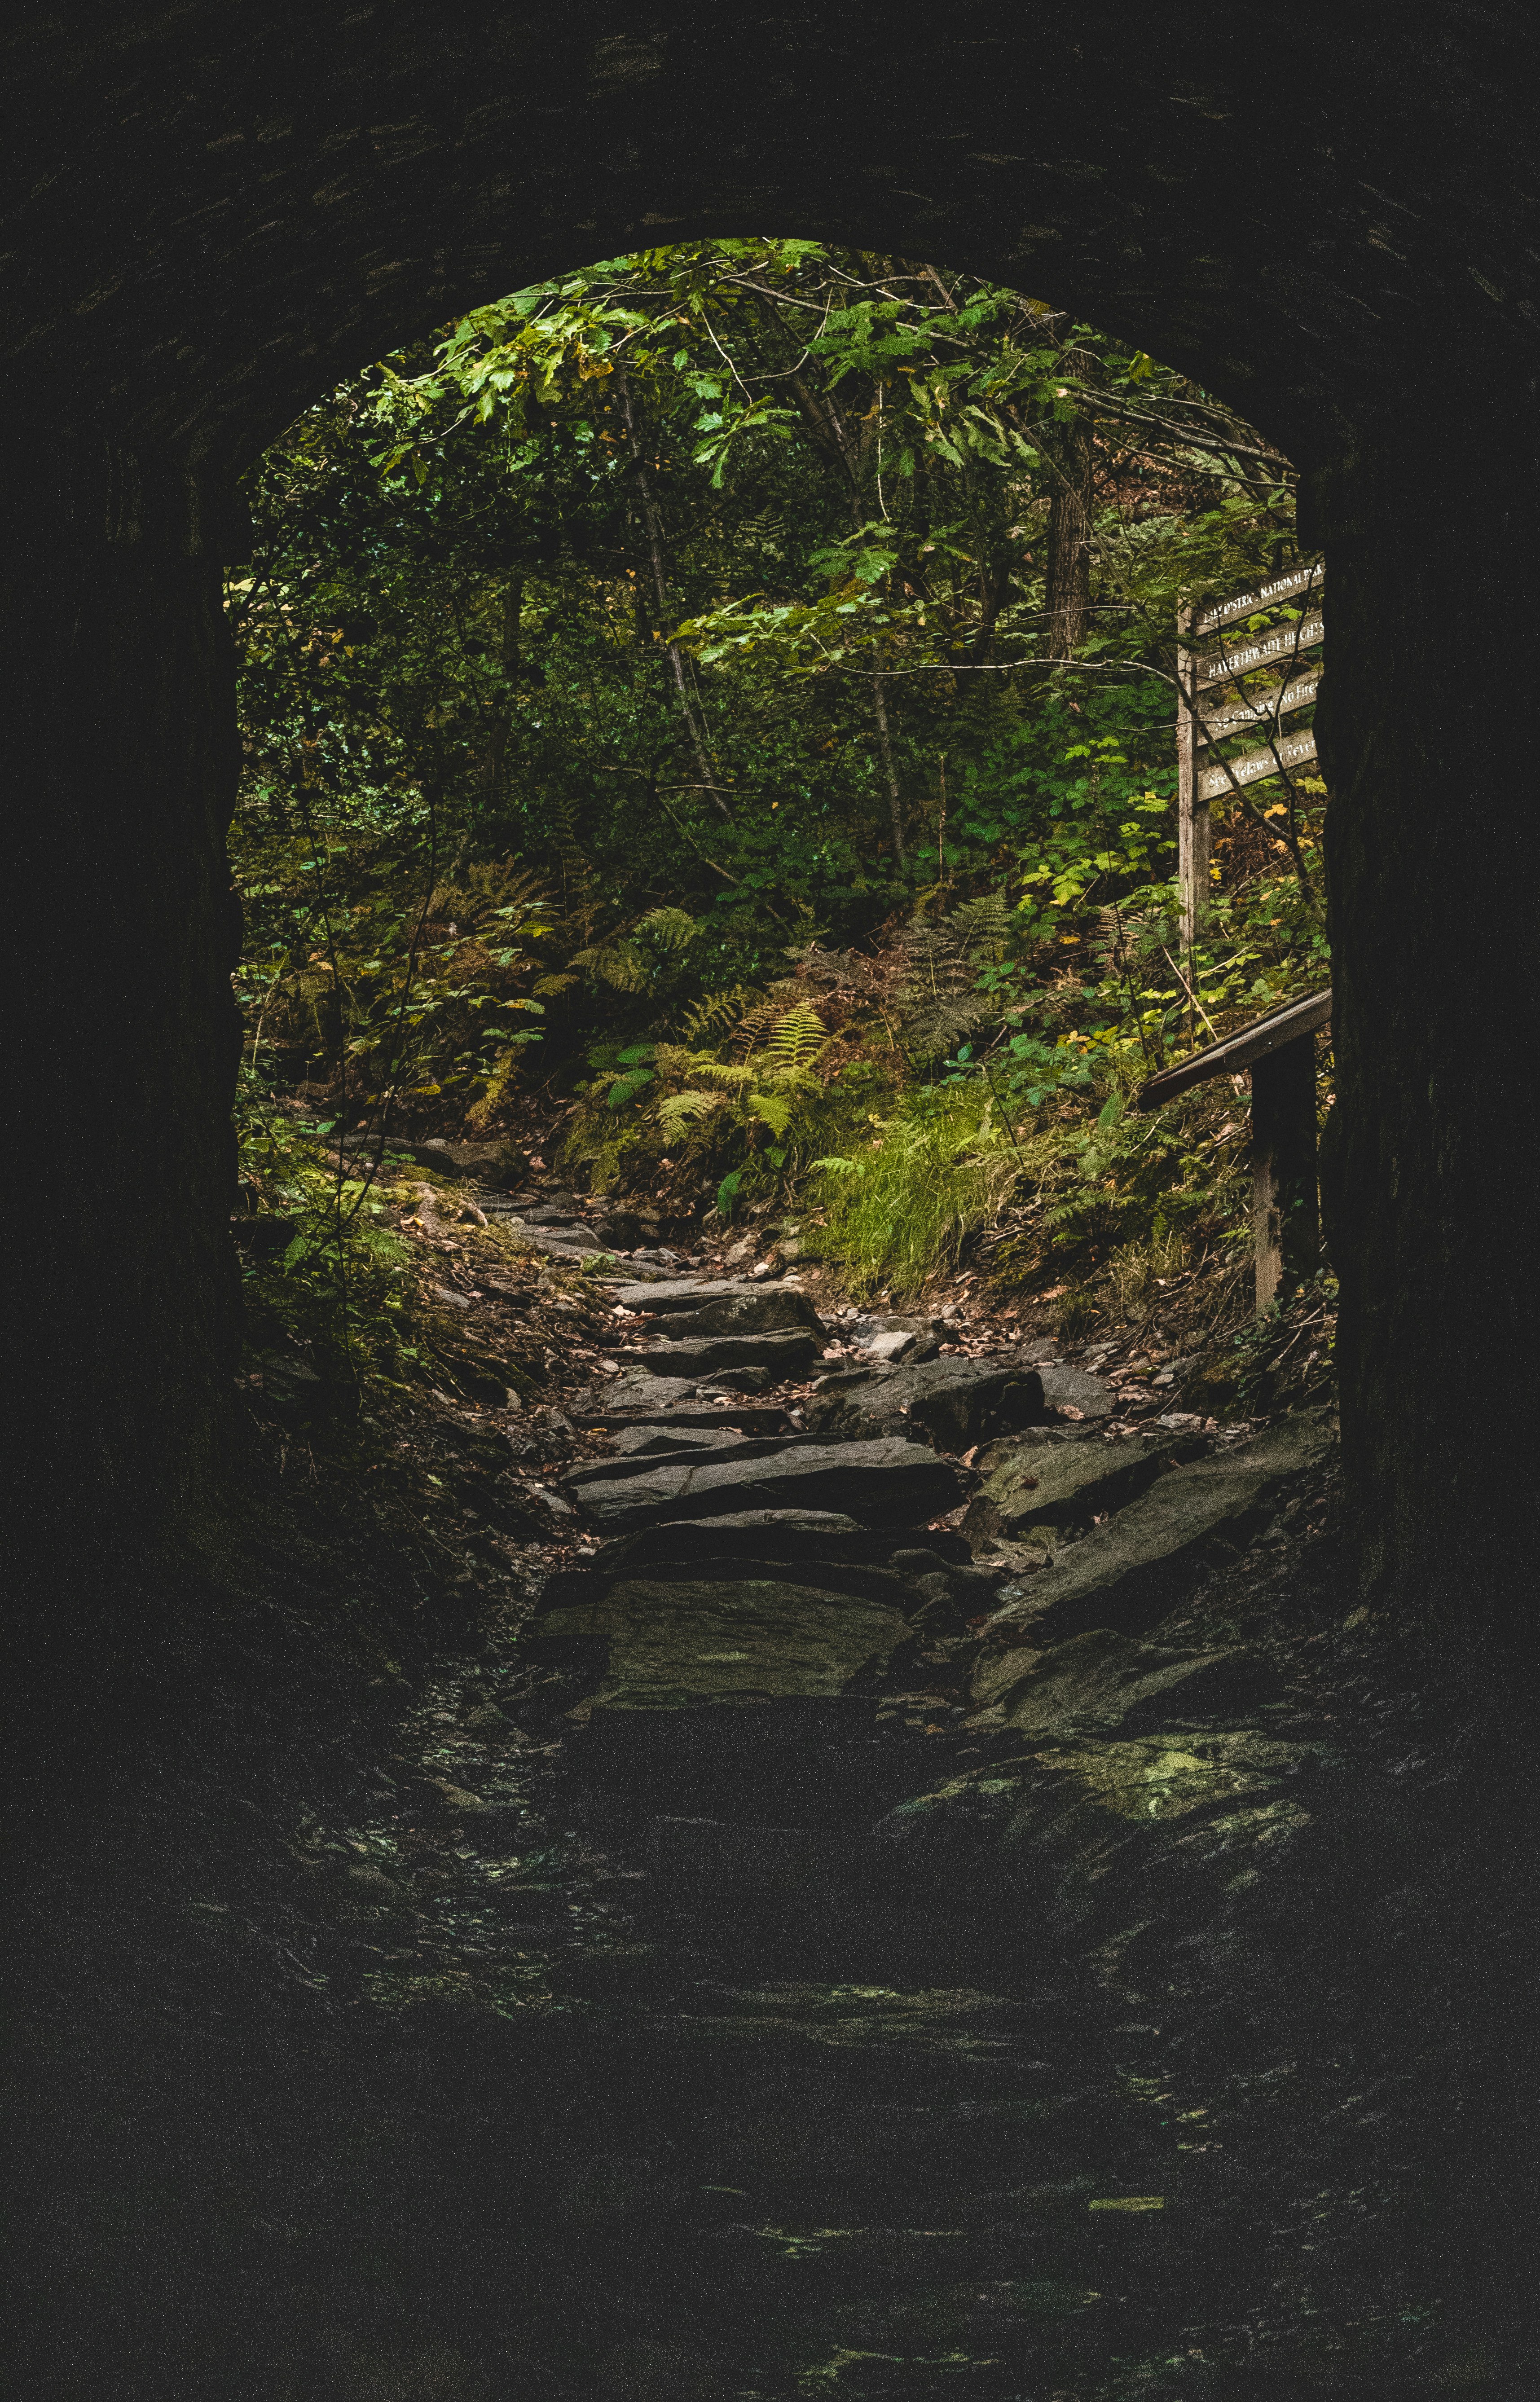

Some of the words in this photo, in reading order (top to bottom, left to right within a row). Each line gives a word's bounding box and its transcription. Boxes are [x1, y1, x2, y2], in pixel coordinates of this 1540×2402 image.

[1224, 593, 1258, 615] DISTRIC
[1261, 573, 1302, 598] NATIONAL
[1209, 638, 1280, 678] HAVERTHWAITE
[1285, 621, 1324, 647] HEGHTS
[1231, 701, 1274, 724] Camping
[1280, 691, 1294, 705] No
[1210, 774, 1227, 787] See
